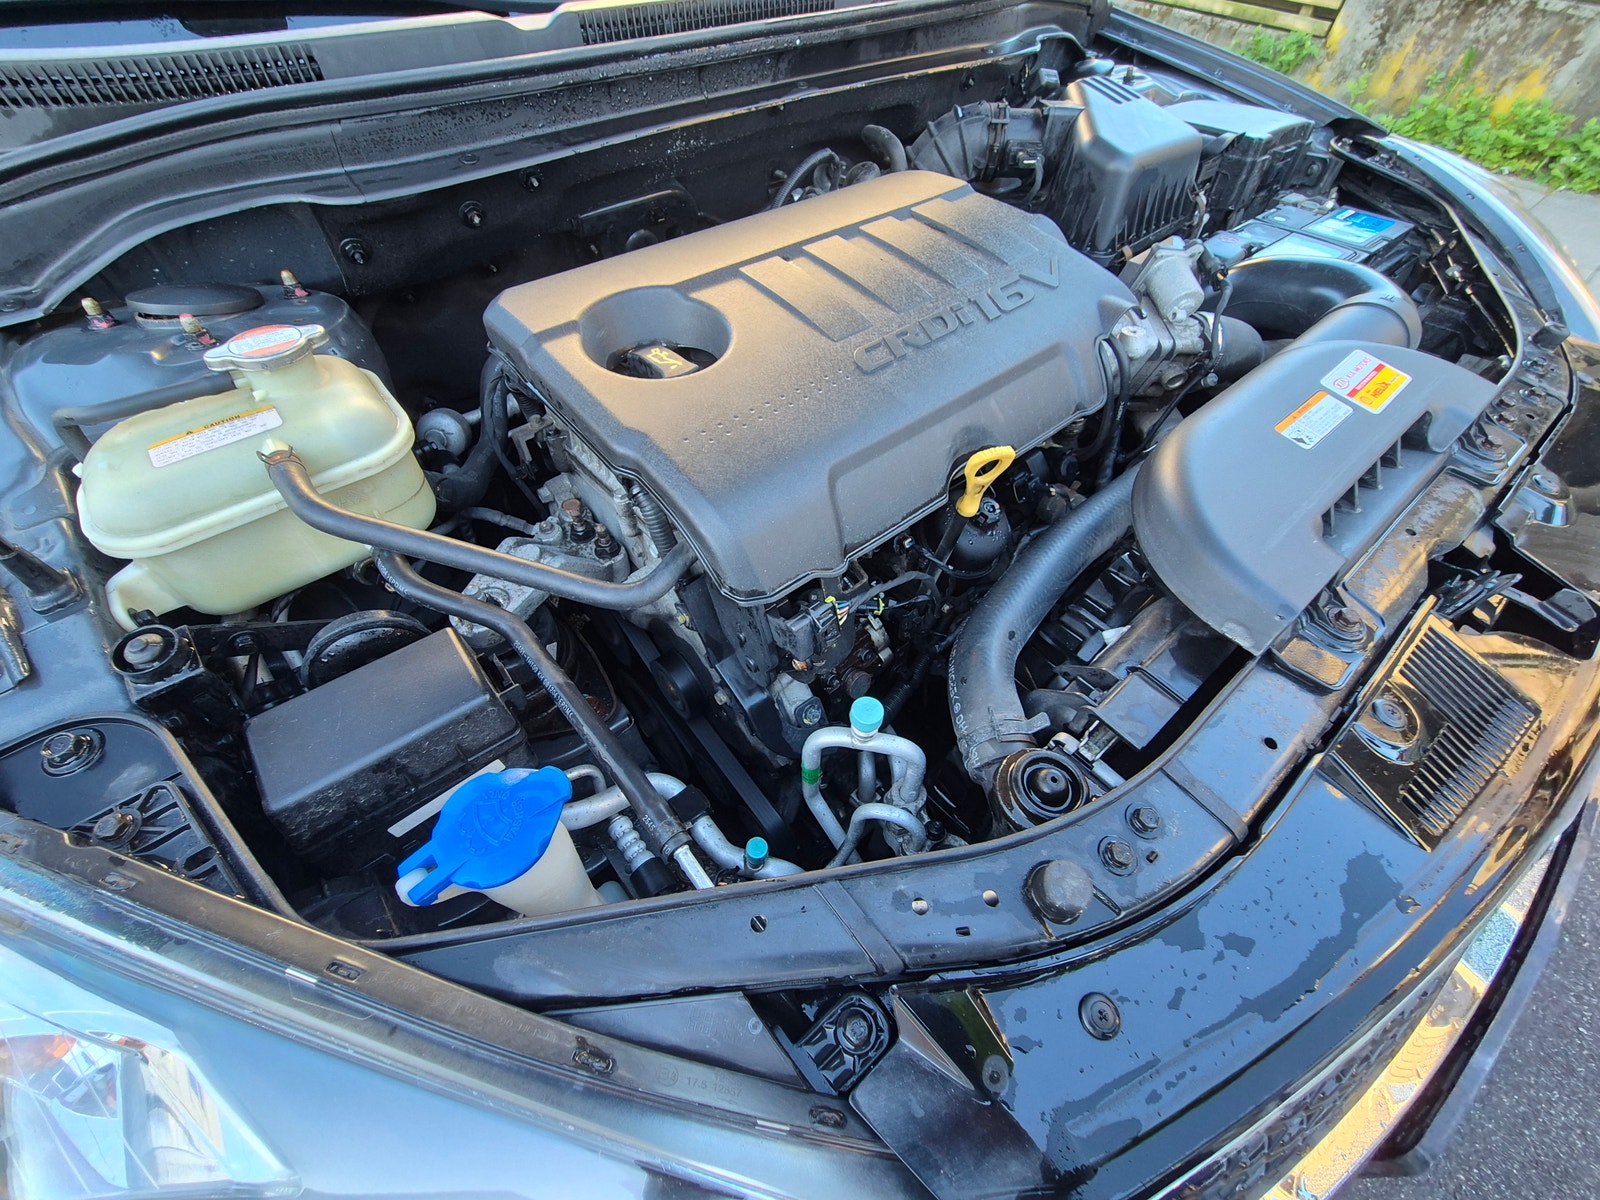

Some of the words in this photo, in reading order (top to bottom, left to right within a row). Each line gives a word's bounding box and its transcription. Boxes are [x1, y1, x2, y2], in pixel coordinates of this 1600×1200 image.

[968, 255, 1060, 321] 16V
[1371, 381, 1392, 399] HELIX
[503, 796, 525, 842] WASHER
